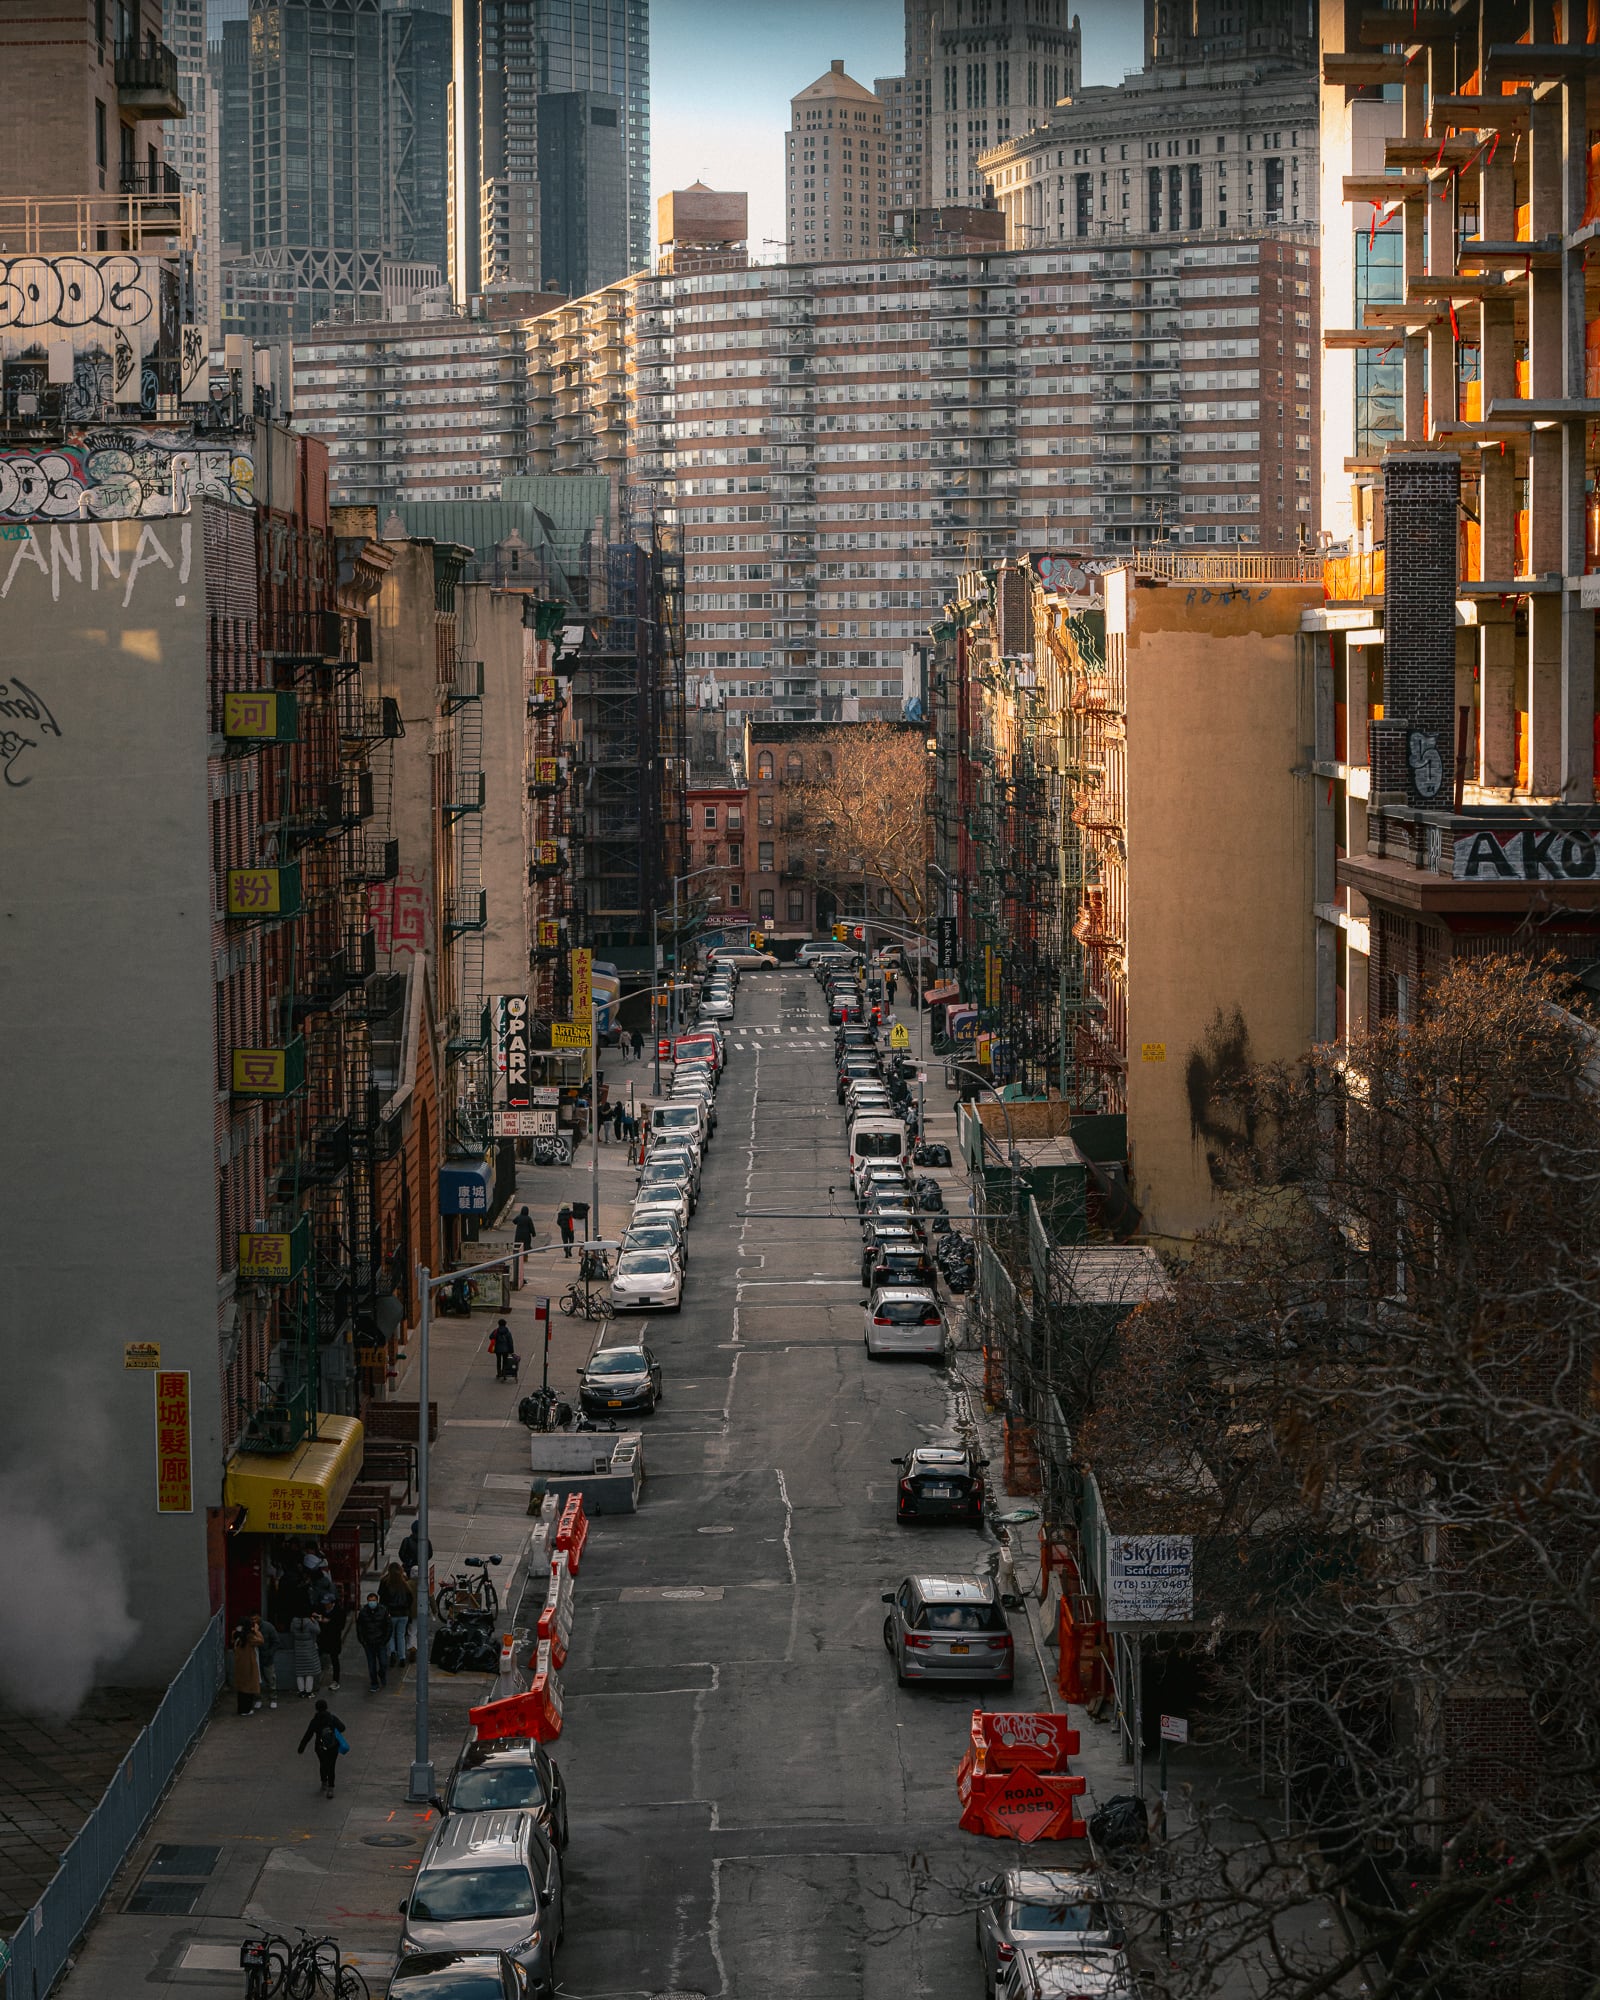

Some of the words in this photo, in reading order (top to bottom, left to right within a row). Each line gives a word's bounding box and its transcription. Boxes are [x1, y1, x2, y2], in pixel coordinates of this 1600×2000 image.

[231, 698, 270, 732] 河
[234, 875, 272, 907] 粉
[509, 1019, 527, 1085] PARK
[240, 1054, 278, 1087] 豆
[248, 1236, 284, 1264] 腐
[159, 1373, 188, 1483] 康城髮廊
[1123, 1542, 1189, 1566] Skyline
[1113, 1580, 1138, 1590] (718)
[1126, 1566, 1187, 1576] Scaffolding
[1005, 1787, 1044, 1801] ROAD
[997, 1801, 1054, 1816] CLOSED
